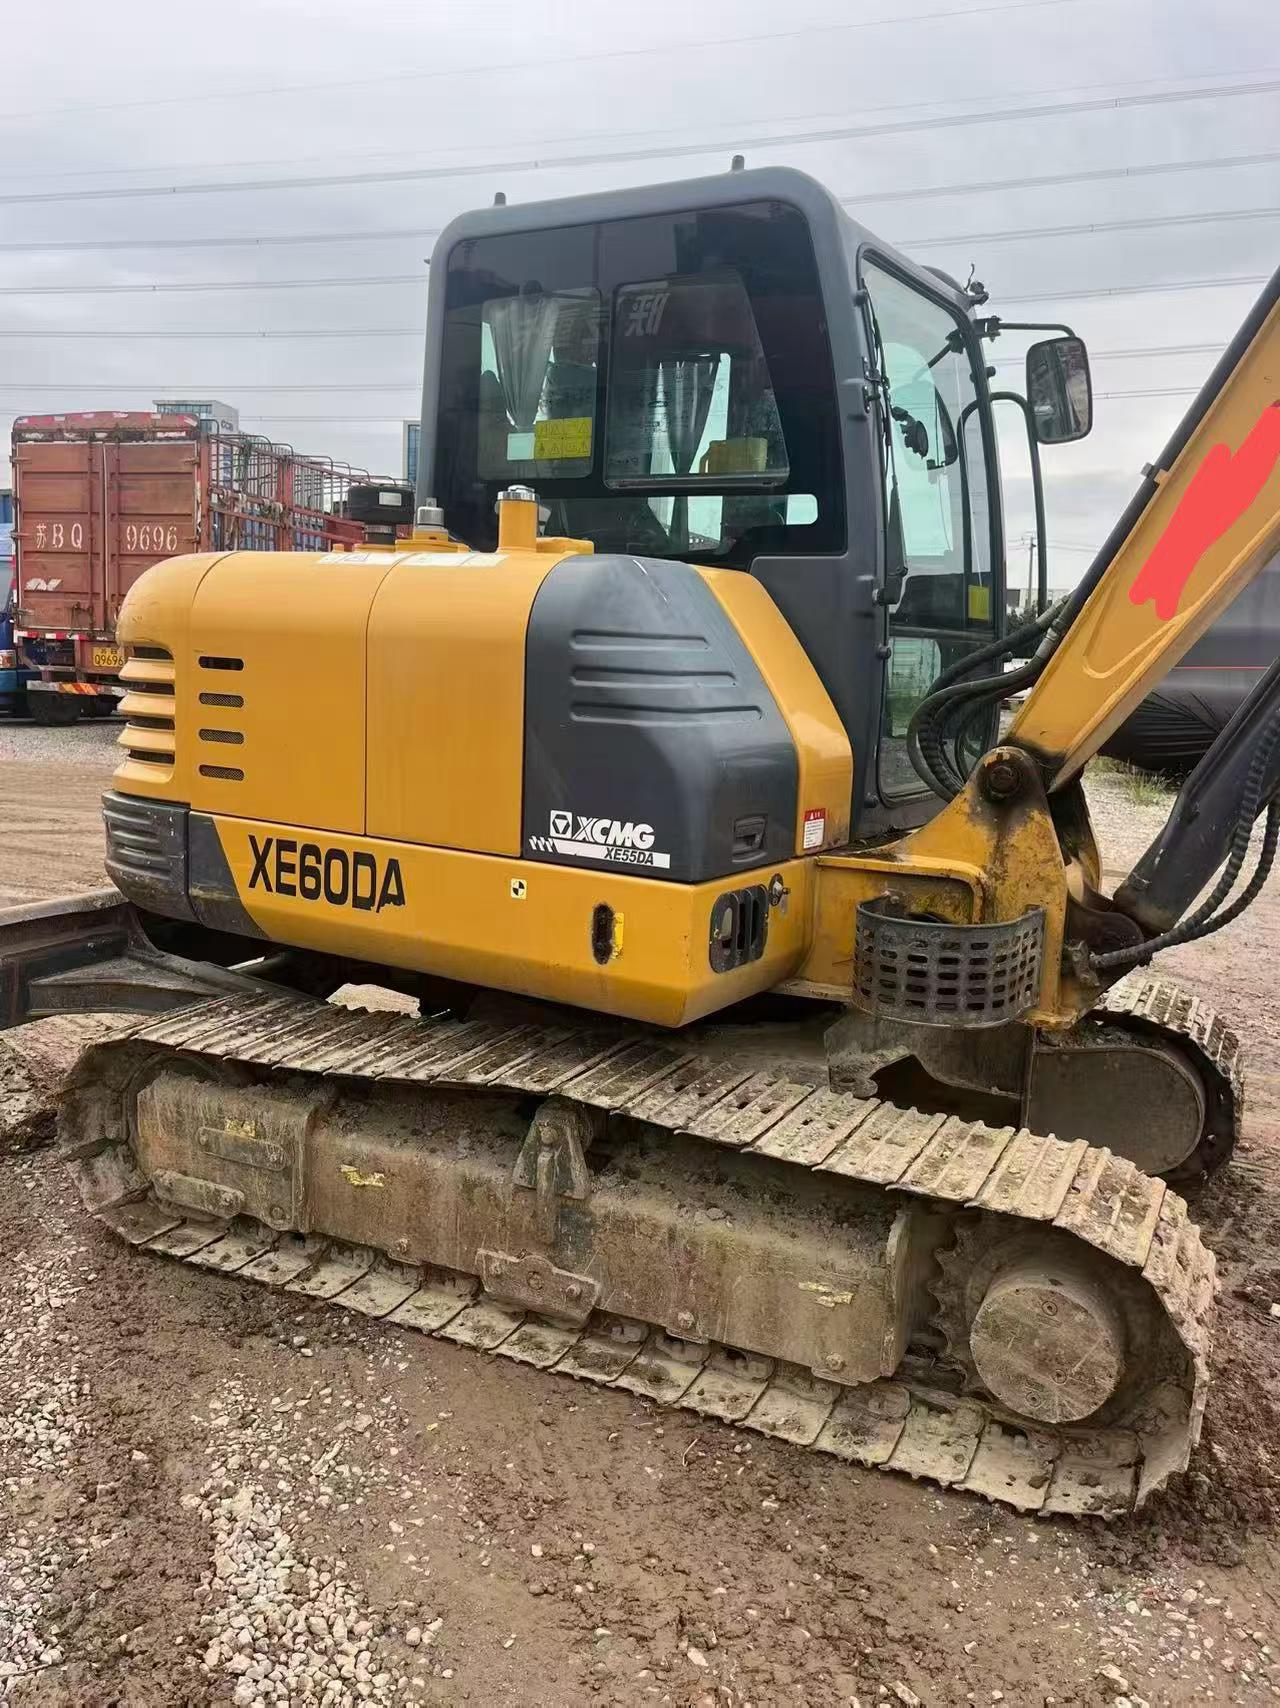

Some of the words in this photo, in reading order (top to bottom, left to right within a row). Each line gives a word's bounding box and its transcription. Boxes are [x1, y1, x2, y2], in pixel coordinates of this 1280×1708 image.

[126, 524, 178, 551] 9696
[572, 815, 656, 850] XCMG
[604, 847, 654, 866] XE55DA
[248, 834, 406, 914] XE60DA
